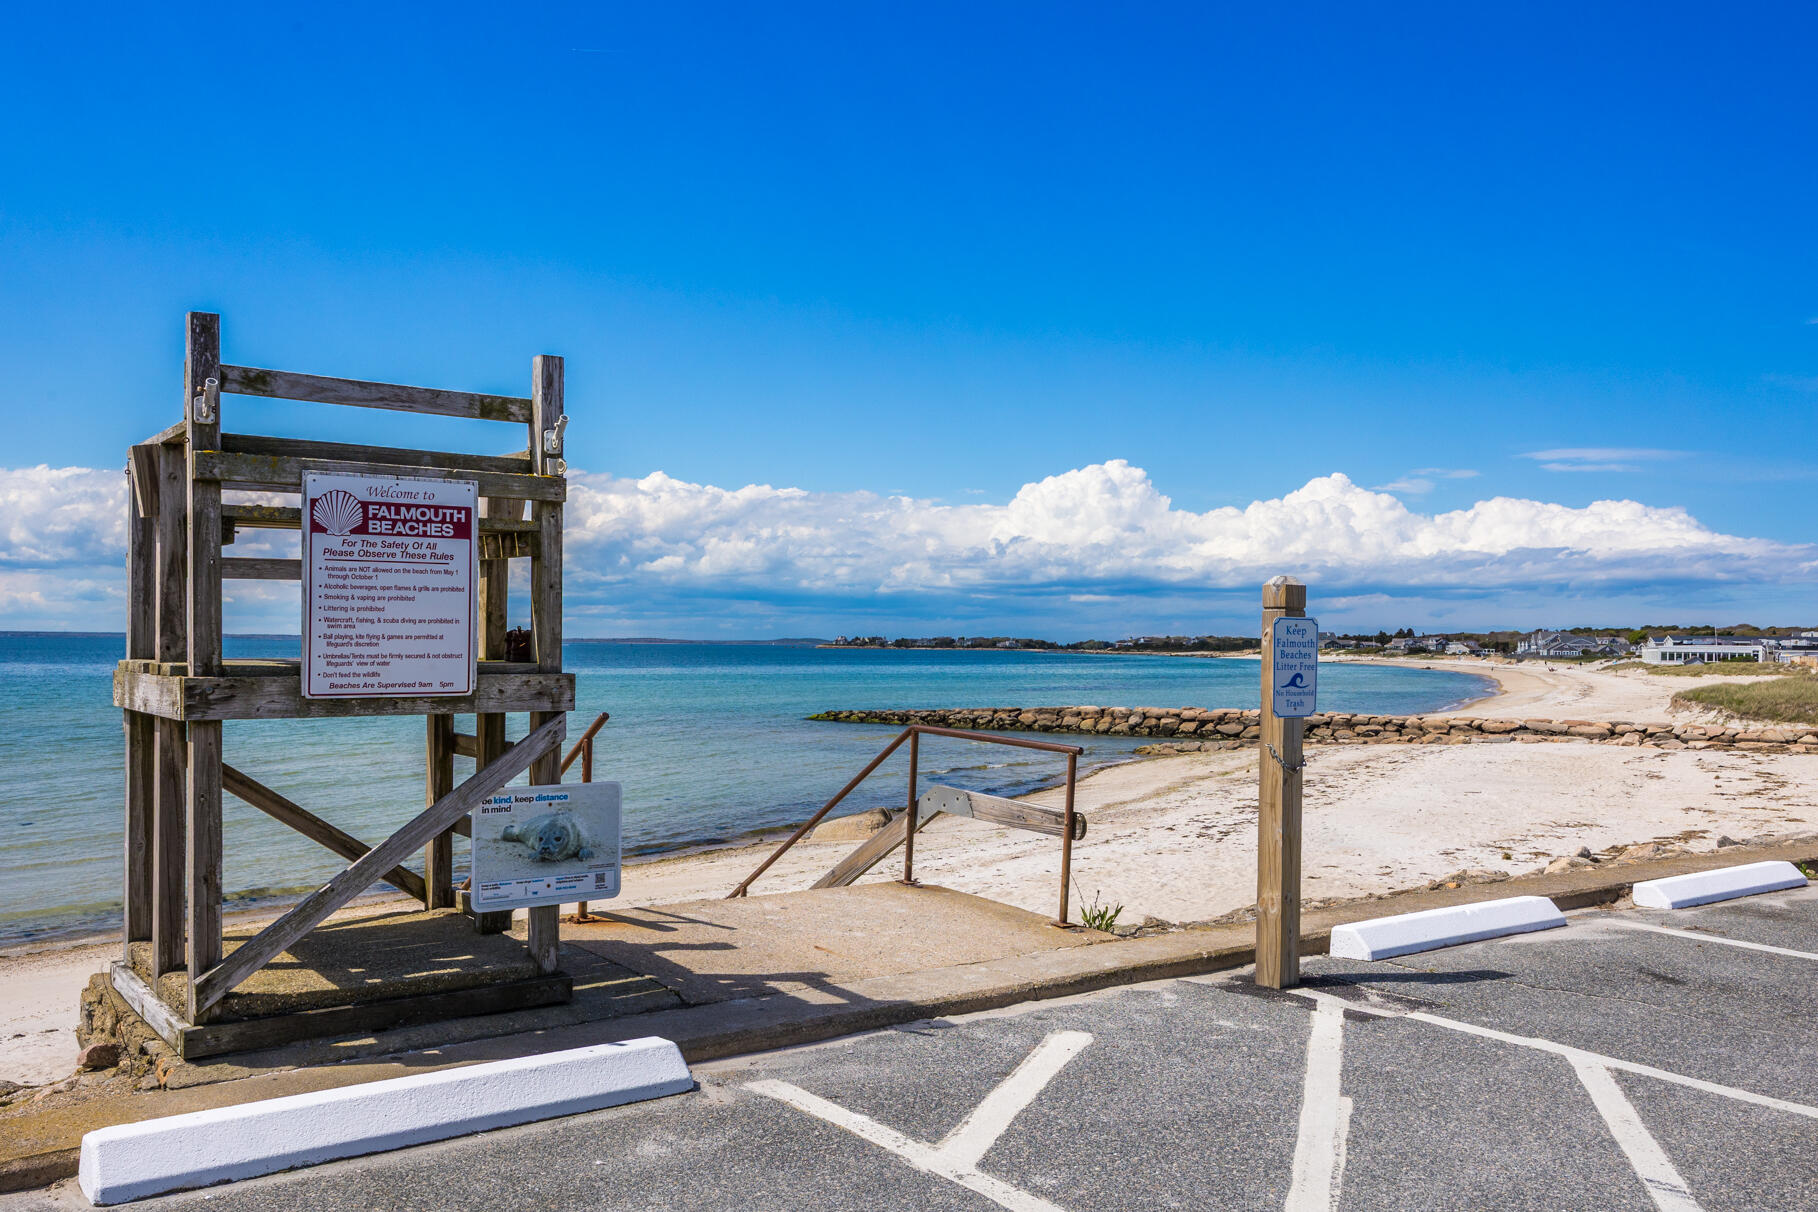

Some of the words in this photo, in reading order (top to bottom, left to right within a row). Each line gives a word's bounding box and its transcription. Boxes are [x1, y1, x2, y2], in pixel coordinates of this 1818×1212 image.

[366, 486, 419, 500] Welcome
[423, 490, 435, 500] to
[368, 505, 465, 522] FALMOUTH
[368, 520, 454, 536] BEACHES
[342, 539, 357, 547] For
[360, 540, 377, 548] The
[381, 540, 409, 552] Safety
[412, 542, 424, 550] Of
[426, 542, 437, 550] All
[323, 548, 354, 557] Please
[358, 549, 396, 558] Observe
[400, 550, 428, 560] These
[430, 552, 454, 560] Rules
[1286, 626, 1307, 638] Keep
[1276, 638, 1315, 648] Falmouth
[1280, 650, 1311, 659] Beaches
[1276, 662, 1297, 671] Litter
[1299, 662, 1315, 671] Free
[1286, 699, 1304, 708] Trash
[493, 795, 513, 804] kind,
[515, 795, 534, 804] keep
[535, 793, 568, 802] distance
[482, 806, 490, 814] in
[491, 805, 511, 814] mind
